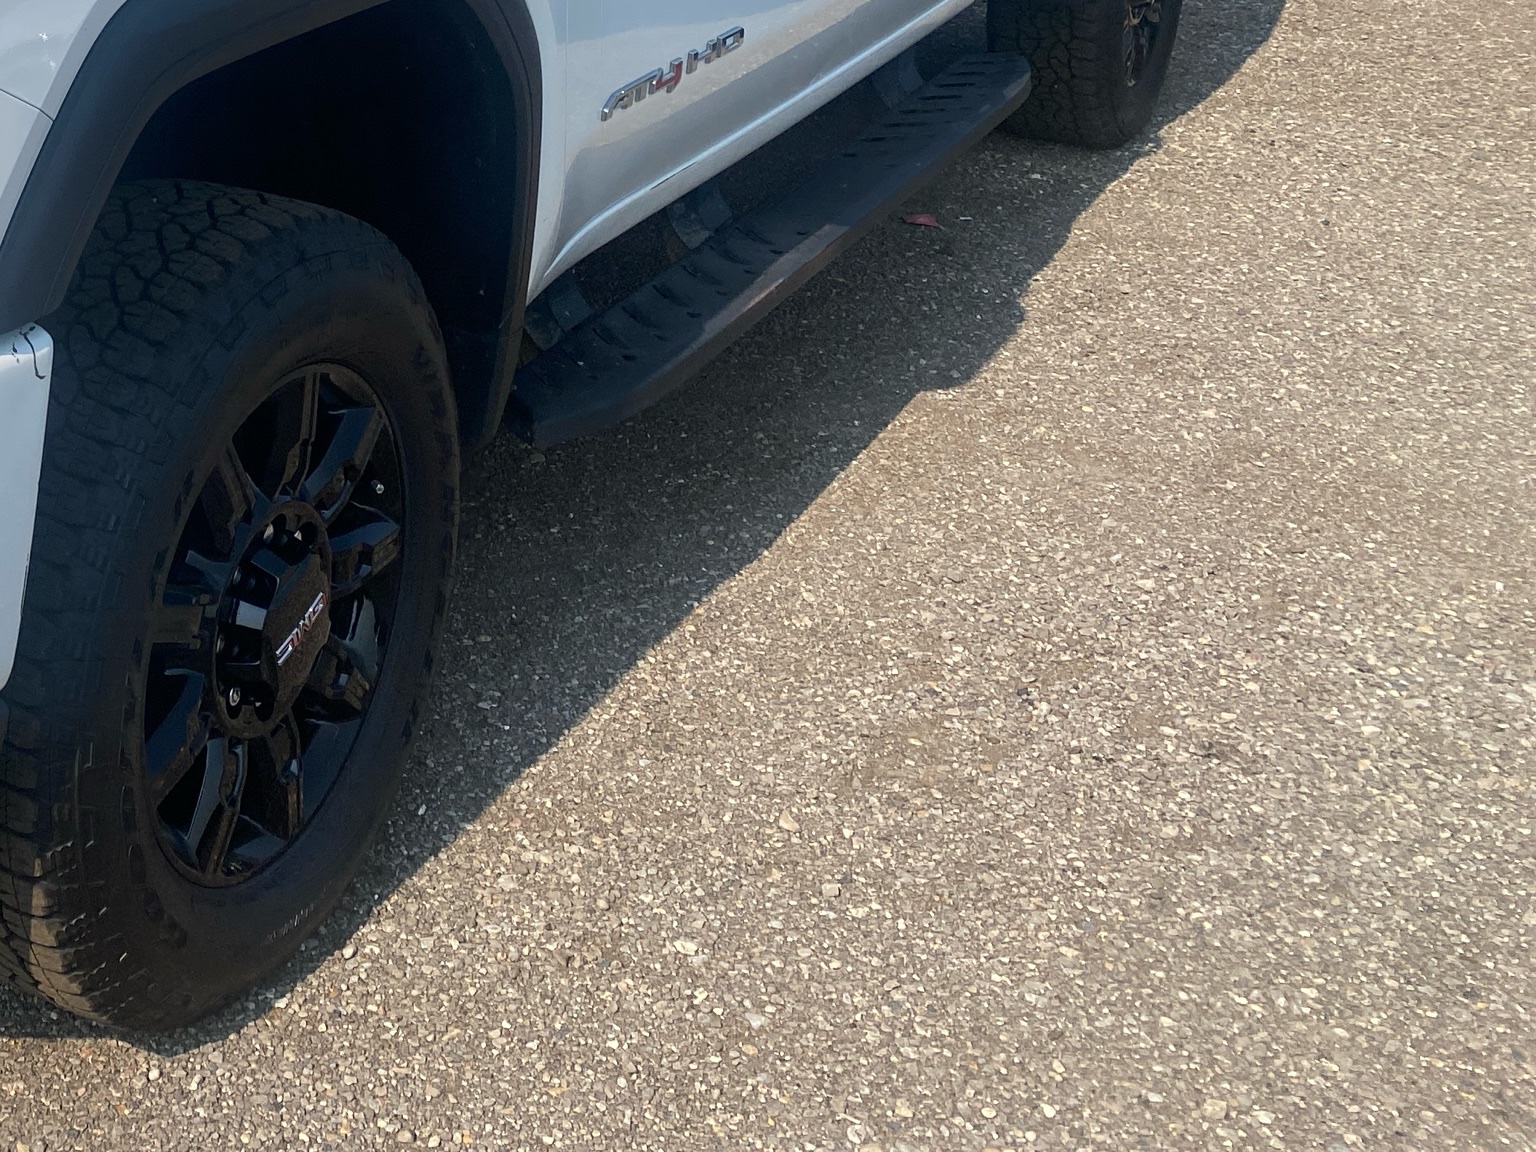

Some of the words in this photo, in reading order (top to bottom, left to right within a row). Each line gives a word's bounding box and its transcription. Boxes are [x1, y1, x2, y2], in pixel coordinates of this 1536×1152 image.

[600, 56, 684, 123] AT4
[685, 25, 745, 75] HD
[275, 591, 327, 667] GMC
